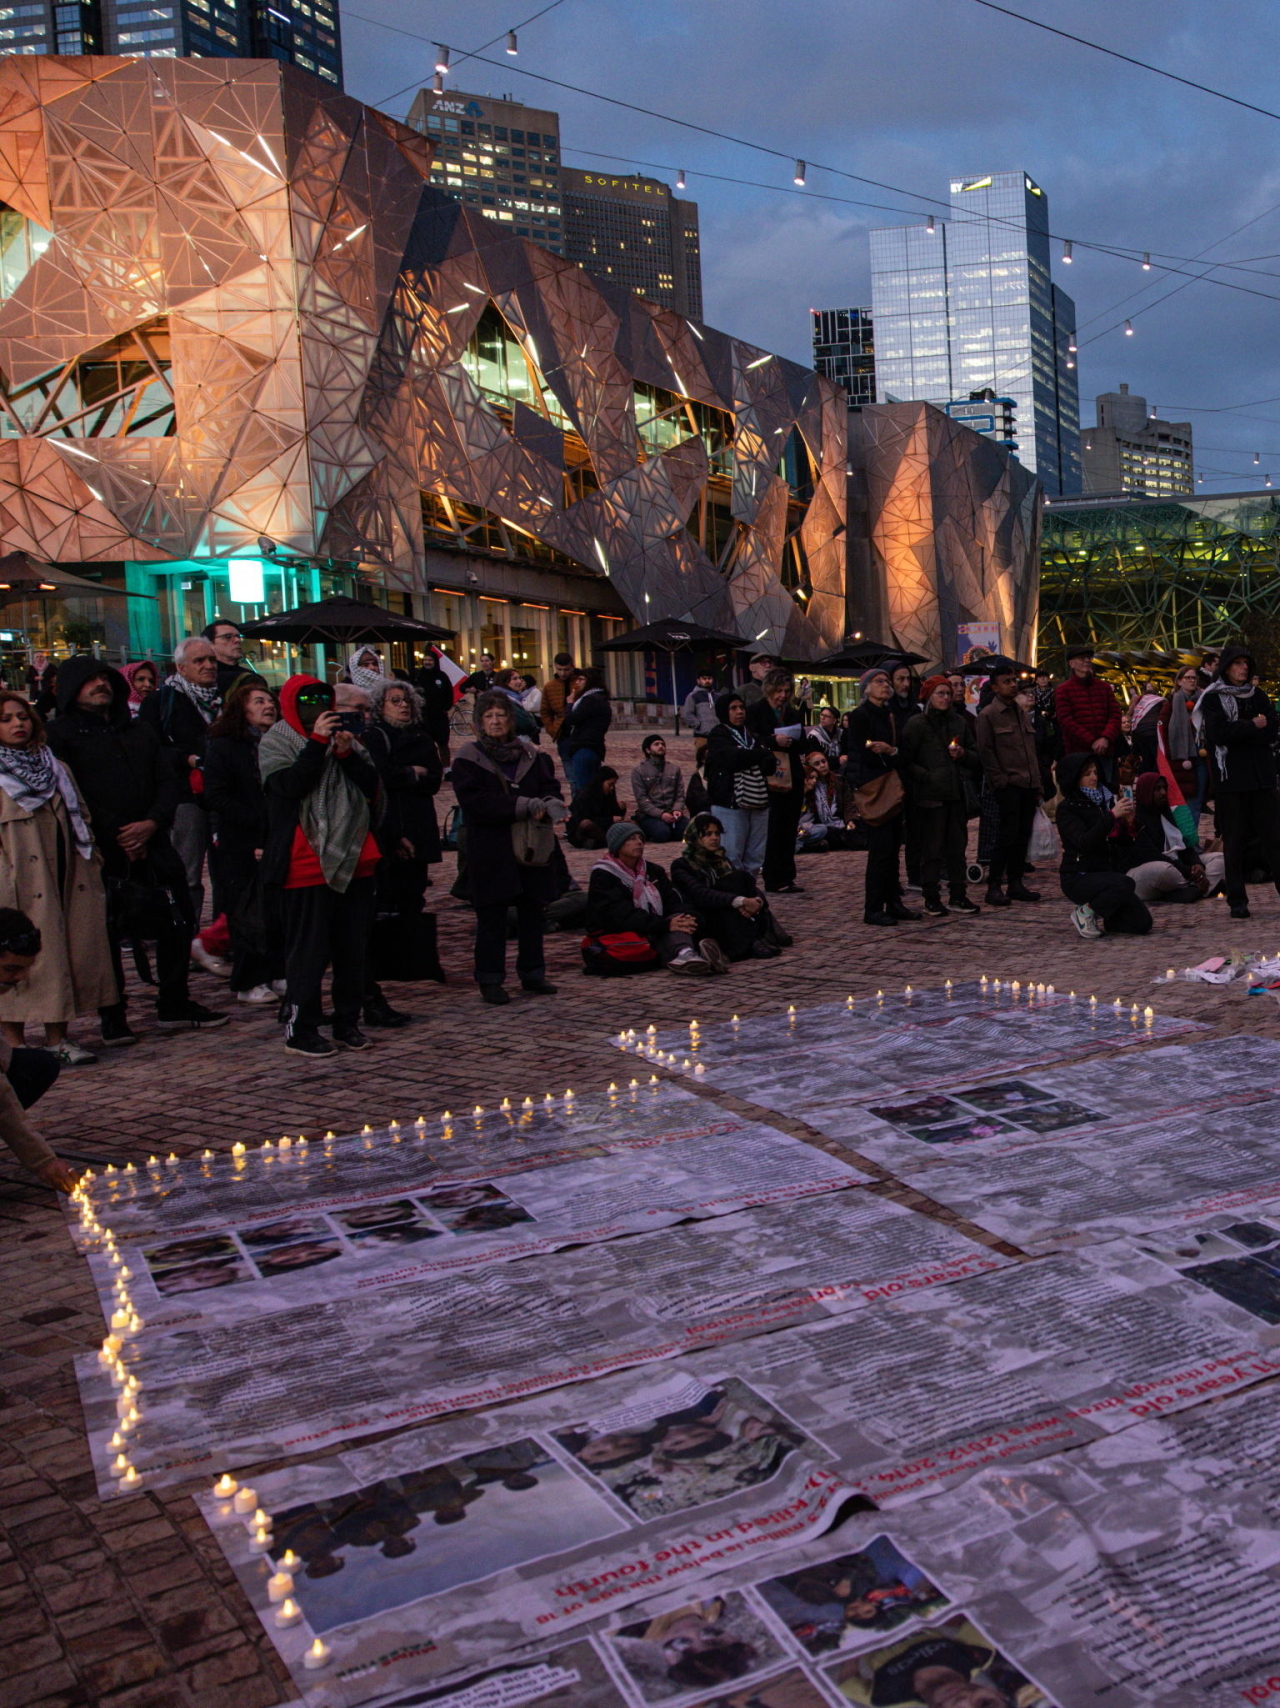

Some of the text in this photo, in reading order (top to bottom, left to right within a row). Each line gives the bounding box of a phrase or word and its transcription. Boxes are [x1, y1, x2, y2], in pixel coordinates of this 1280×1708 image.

[432, 99, 466, 115] ANZ
[584, 175, 665, 196] SOFITEL
[745, 1196, 778, 1206] old
[908, 1266, 976, 1288] years
[862, 1284, 903, 1301] old
[686, 1313, 755, 1334] school
[1128, 1360, 1280, 1418] 11 years old
[555, 1352, 1258, 1597] Lived through three wars (2012, 2014, killed in the fourth
[745, 1521, 804, 1548] million
[726, 1544, 744, 1554] is
[666, 1550, 725, 1577] below
[628, 1575, 663, 1589] the
[588, 1587, 625, 1604] age
[562, 1603, 584, 1615] of
[536, 1612, 558, 1625] 18
[504, 1679, 537, 1693] Great
